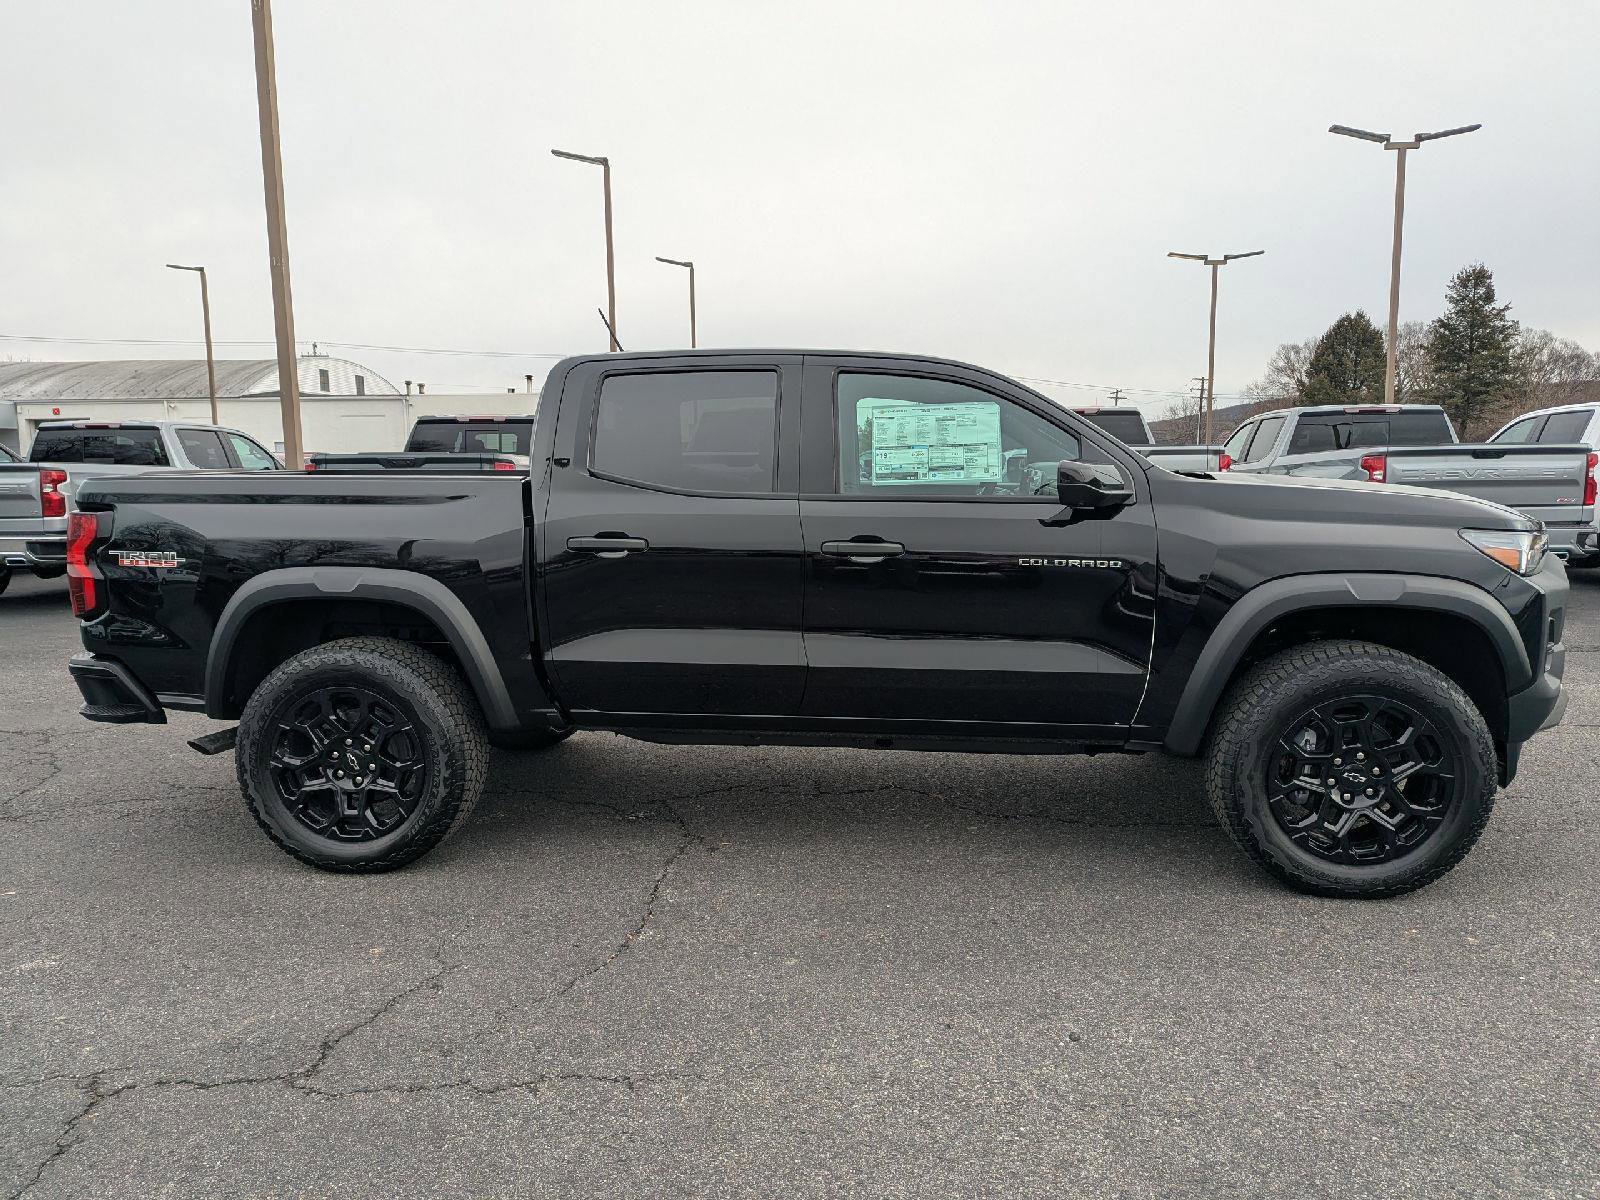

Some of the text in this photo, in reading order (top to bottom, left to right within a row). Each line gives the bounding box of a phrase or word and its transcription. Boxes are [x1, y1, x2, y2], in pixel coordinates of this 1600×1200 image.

[109, 550, 185, 561] TRAIL
[118, 560, 177, 568] BOSS
[1019, 558, 1122, 568] COLORADO
